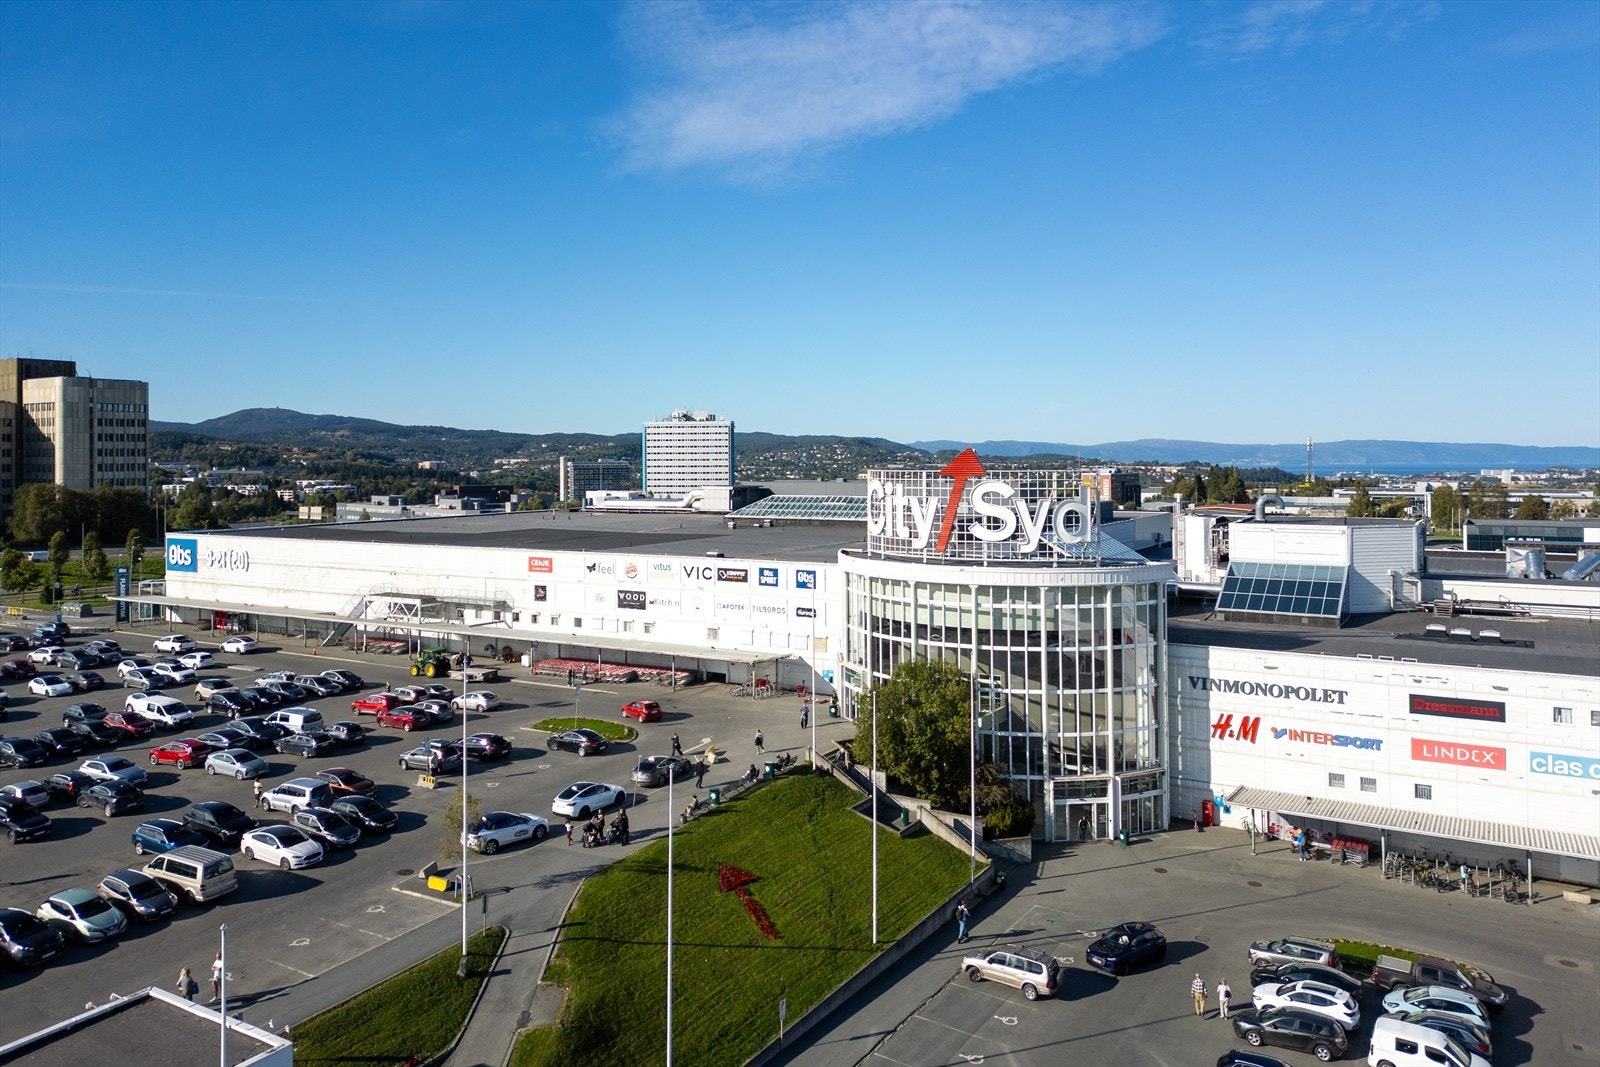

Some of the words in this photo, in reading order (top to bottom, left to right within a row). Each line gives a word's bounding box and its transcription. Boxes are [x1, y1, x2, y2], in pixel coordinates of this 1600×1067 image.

[867, 479, 939, 549] City
[968, 480, 1092, 553] Syd
[597, 562, 615, 575] feel
[653, 563, 672, 572] vitus
[683, 565, 713, 580] VIC
[618, 592, 646, 601] WOOD
[752, 605, 786, 615] TILBORDS
[1188, 675, 1349, 704] VINMONOPOLET
[1413, 698, 1501, 718] Dressmann
[1211, 713, 1261, 745] H&M
[1287, 728, 1384, 751] INTERSPORT
[1422, 744, 1496, 765] LINDEX
[1531, 754, 1584, 777] clas
